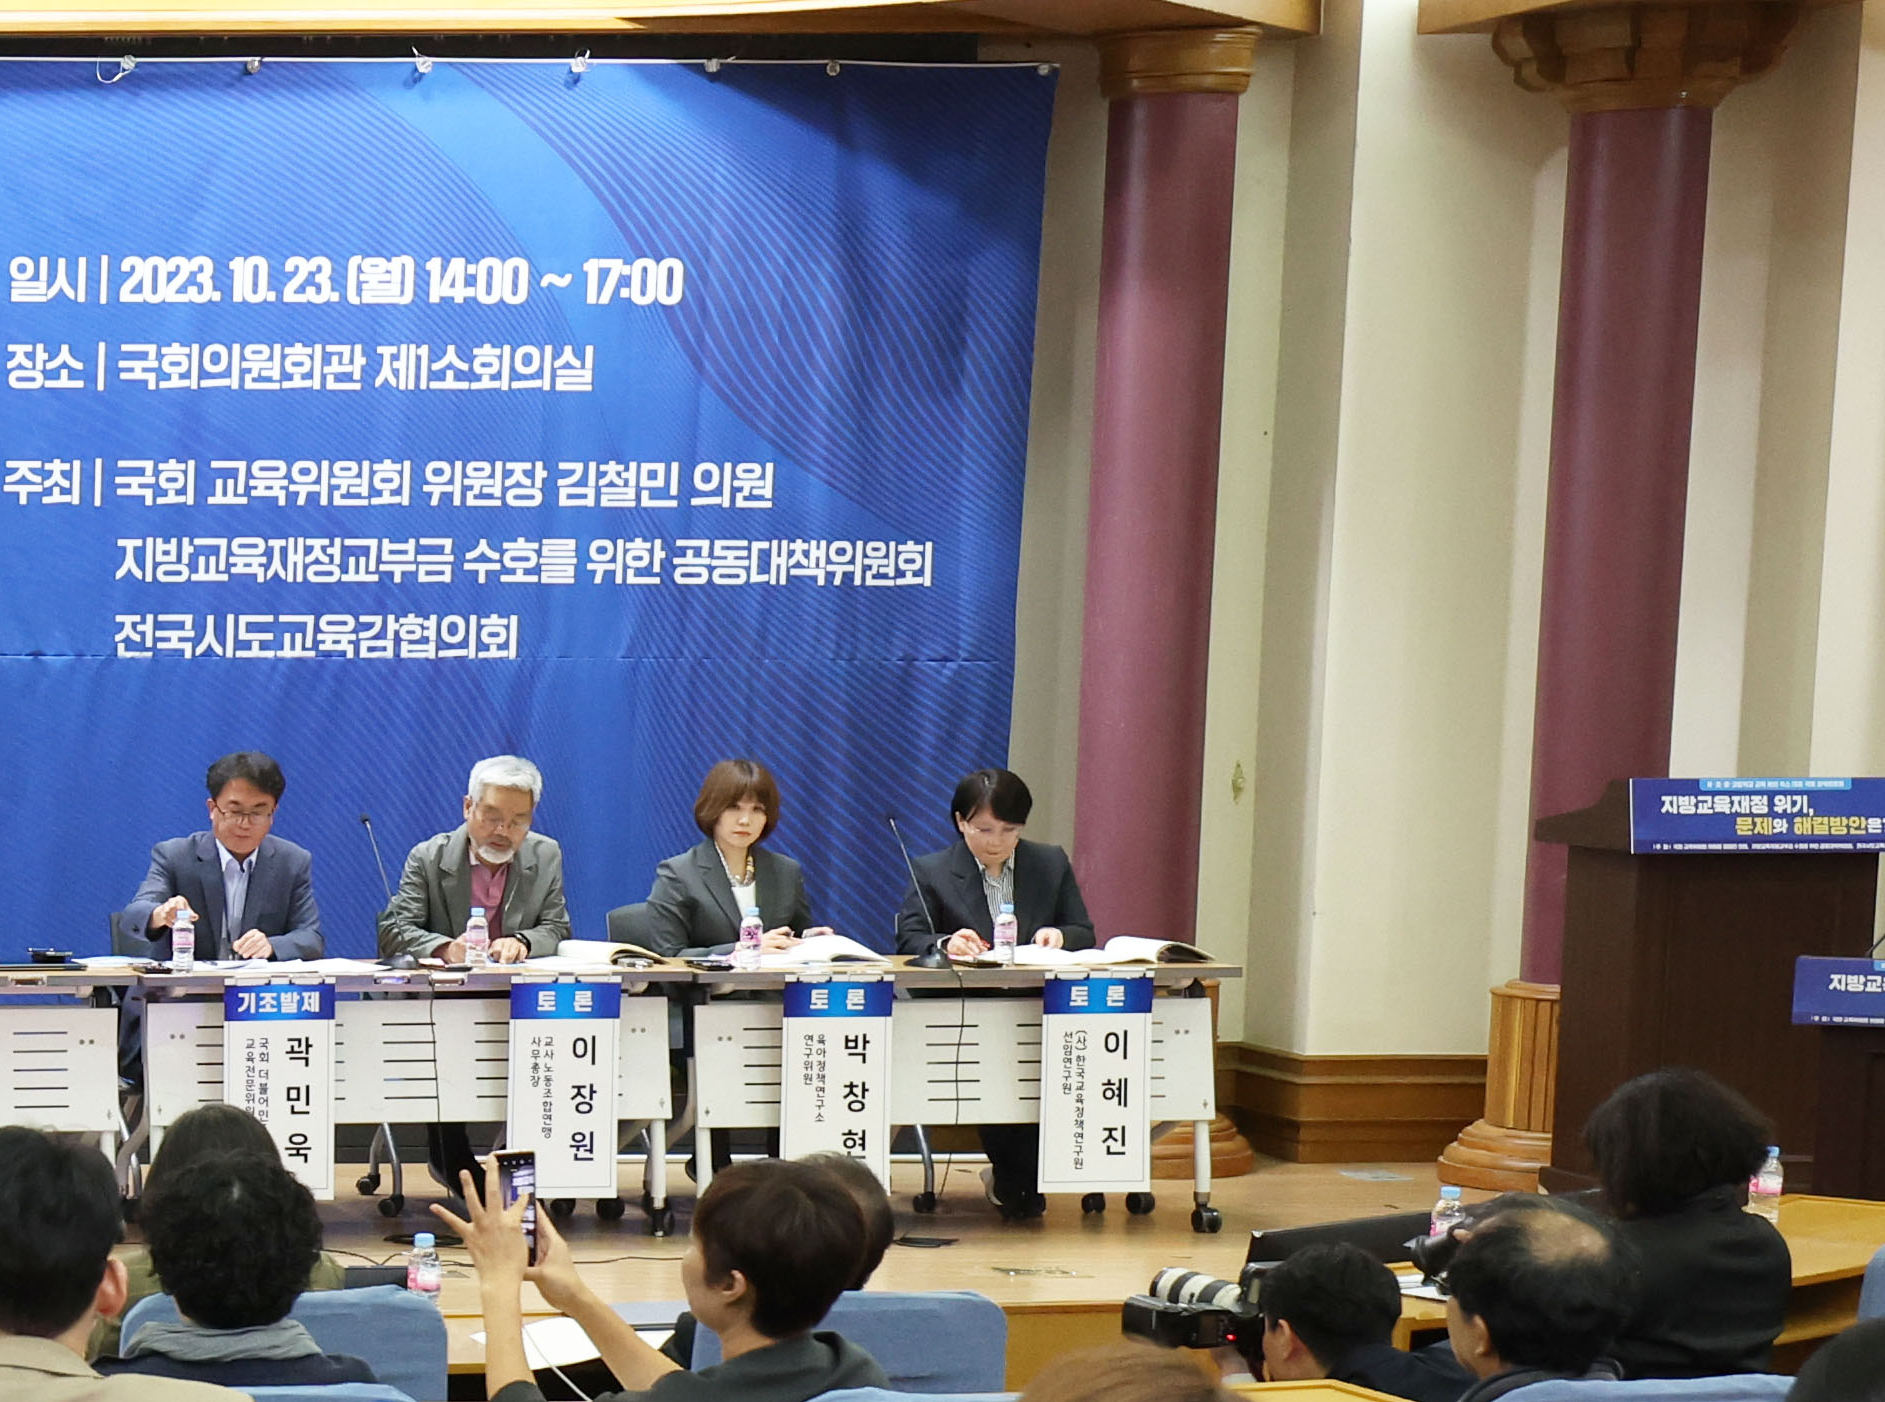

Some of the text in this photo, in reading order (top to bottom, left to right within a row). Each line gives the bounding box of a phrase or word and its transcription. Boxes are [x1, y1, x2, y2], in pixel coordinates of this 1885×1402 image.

[9, 256, 87, 303] 일시
[119, 255, 222, 304] 2023.
[228, 255, 277, 304] 10.
[282, 255, 340, 305] 23.
[346, 254, 415, 305] (월)
[425, 256, 529, 305] 14:00
[582, 257, 684, 306] 17:00
[6, 343, 85, 389] 장소
[117, 342, 367, 391] 국회의원회관
[374, 343, 594, 391] 제1소회의실
[3, 458, 81, 505] 주최
[114, 458, 196, 506] 국회
[207, 458, 411, 506] 교육위원회
[422, 460, 548, 507] 위원장
[557, 460, 679, 508] 김철민
[690, 462, 774, 508] 의원
[115, 536, 933, 587] 지방교육재정교부금 수호를 위한 공동대책위원회
[114, 613, 518, 660] 전국시도교육감협의회
[1660, 794, 1814, 816] 지방교육재정 위기,
[1735, 816, 1885, 836] 문제와 해결방안은
[237, 991, 320, 1014] 기조발제
[537, 990, 593, 1012] 토론
[809, 988, 865, 1010] 토론
[1069, 985, 1125, 1007] 토론
[1828, 973, 1885, 993] 지방교
[257, 1068, 269, 1124] 더불어민
[284, 1036, 314, 1164] 곽민욱
[569, 1035, 598, 1162] 이장원
[839, 1033, 871, 1161] 박창현
[1101, 1029, 1128, 1156] 이혜진
